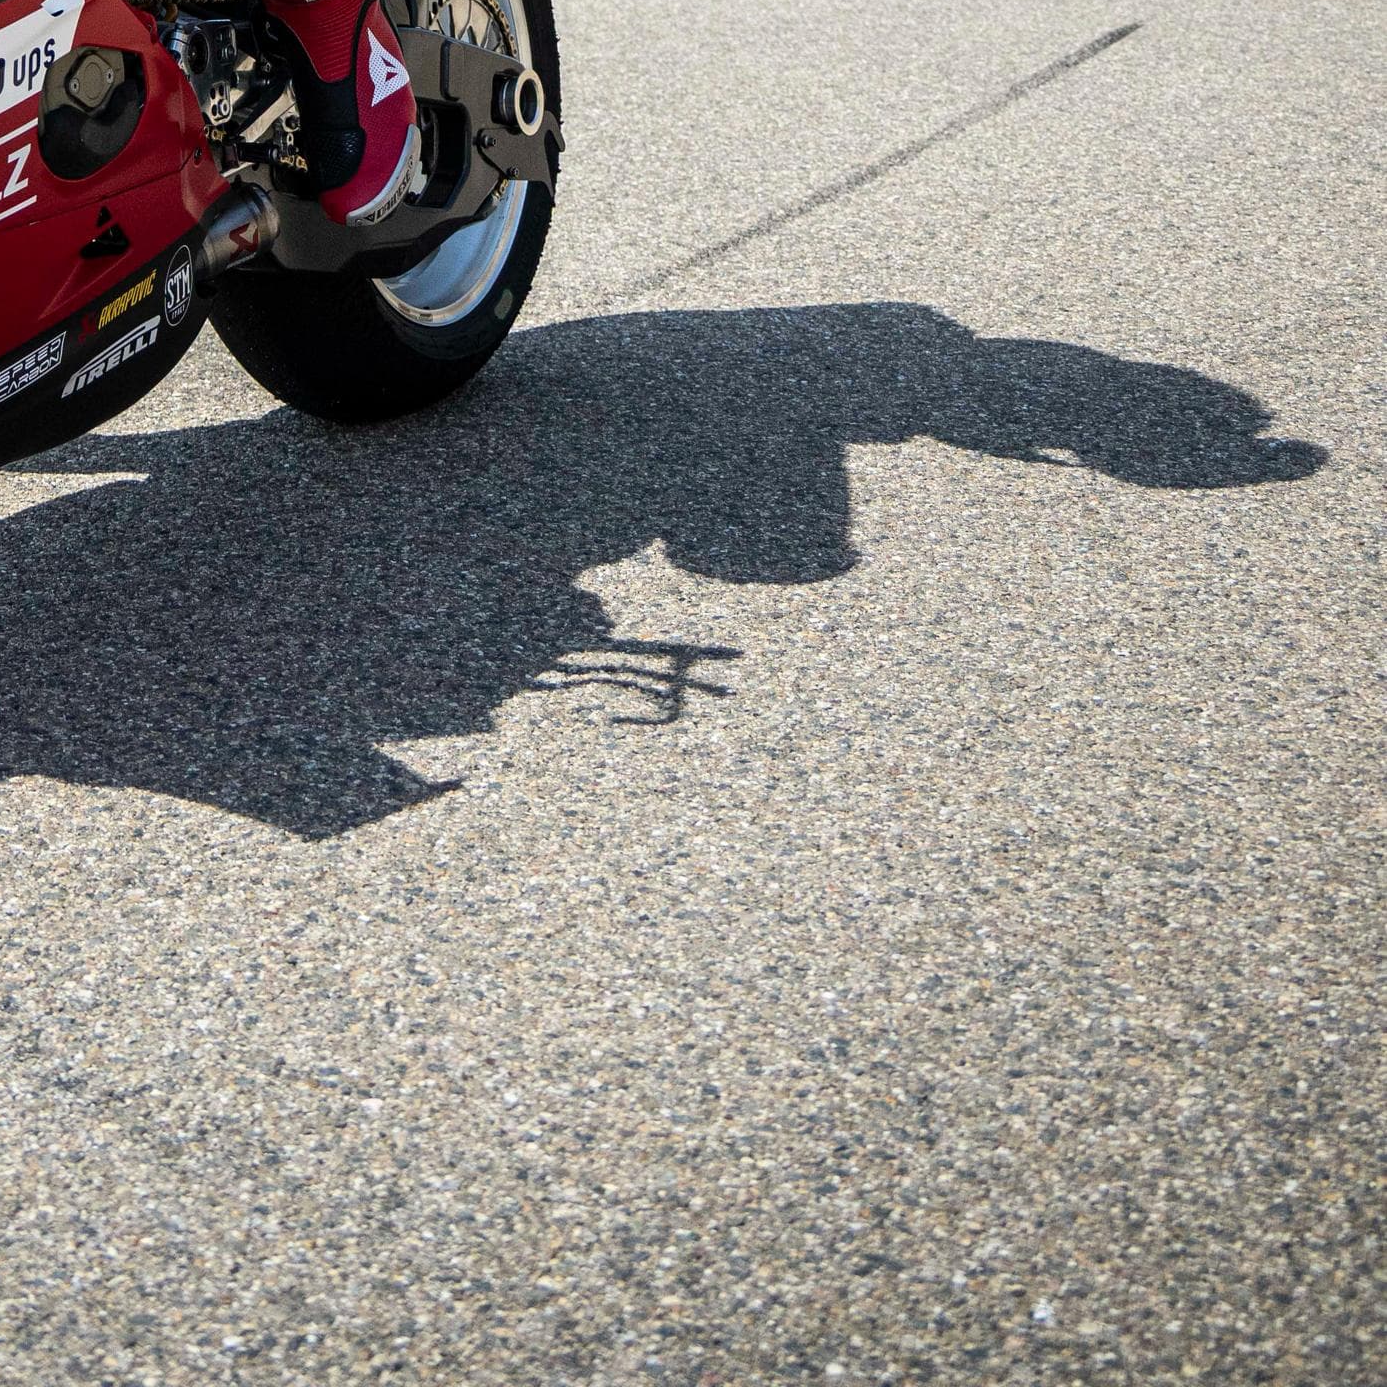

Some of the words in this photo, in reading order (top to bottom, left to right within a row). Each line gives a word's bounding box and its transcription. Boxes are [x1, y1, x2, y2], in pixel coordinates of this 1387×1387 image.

[13, 37, 57, 92] ups
[166, 262, 191, 310] STM
[60, 314, 162, 399] PIRELLI
